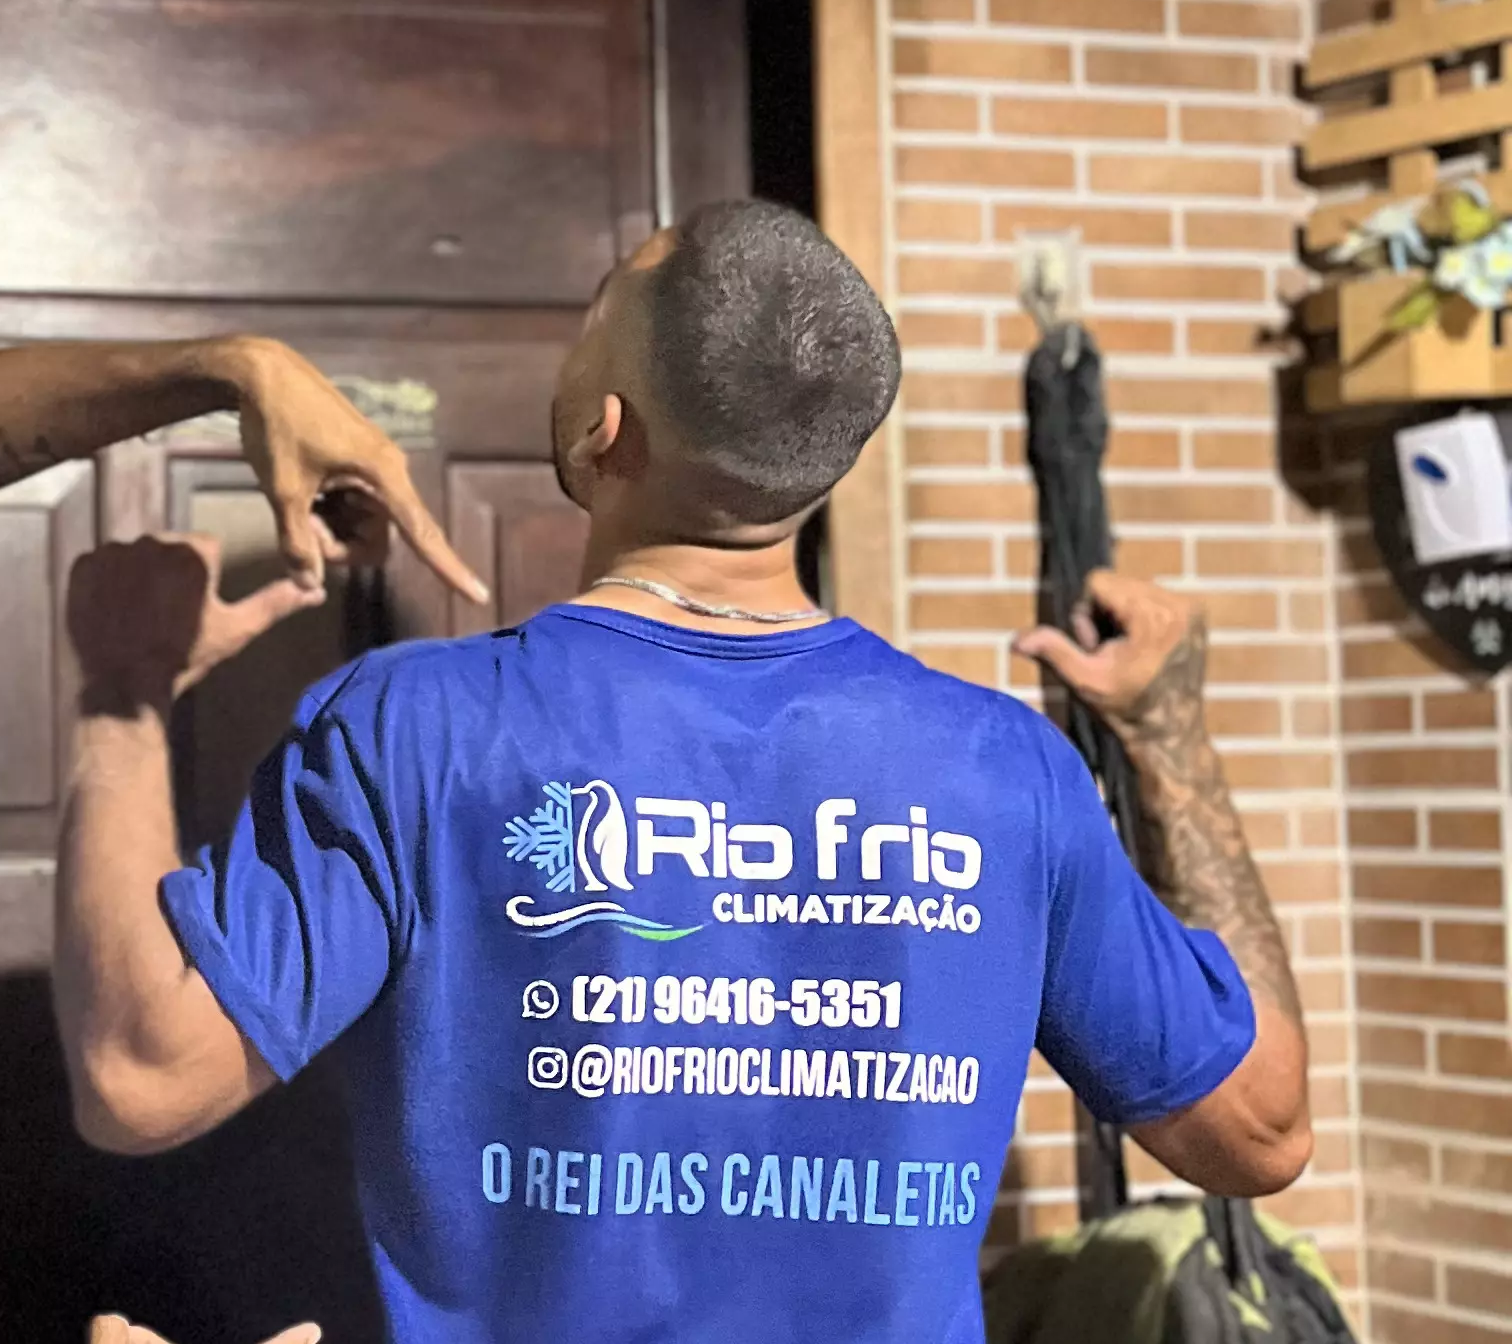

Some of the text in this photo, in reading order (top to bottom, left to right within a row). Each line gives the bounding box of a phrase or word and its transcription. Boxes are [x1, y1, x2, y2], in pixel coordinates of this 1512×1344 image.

[635, 796, 982, 890] Rio frio
[712, 892, 981, 934] CLIMATIZAÇÃO
[572, 975, 901, 1028] (21) 96416-5351
[572, 1044, 979, 1105] @RIOFRIOCLIMATIZACAO
[482, 1142, 980, 1226] O REI DAS CANALETAS
